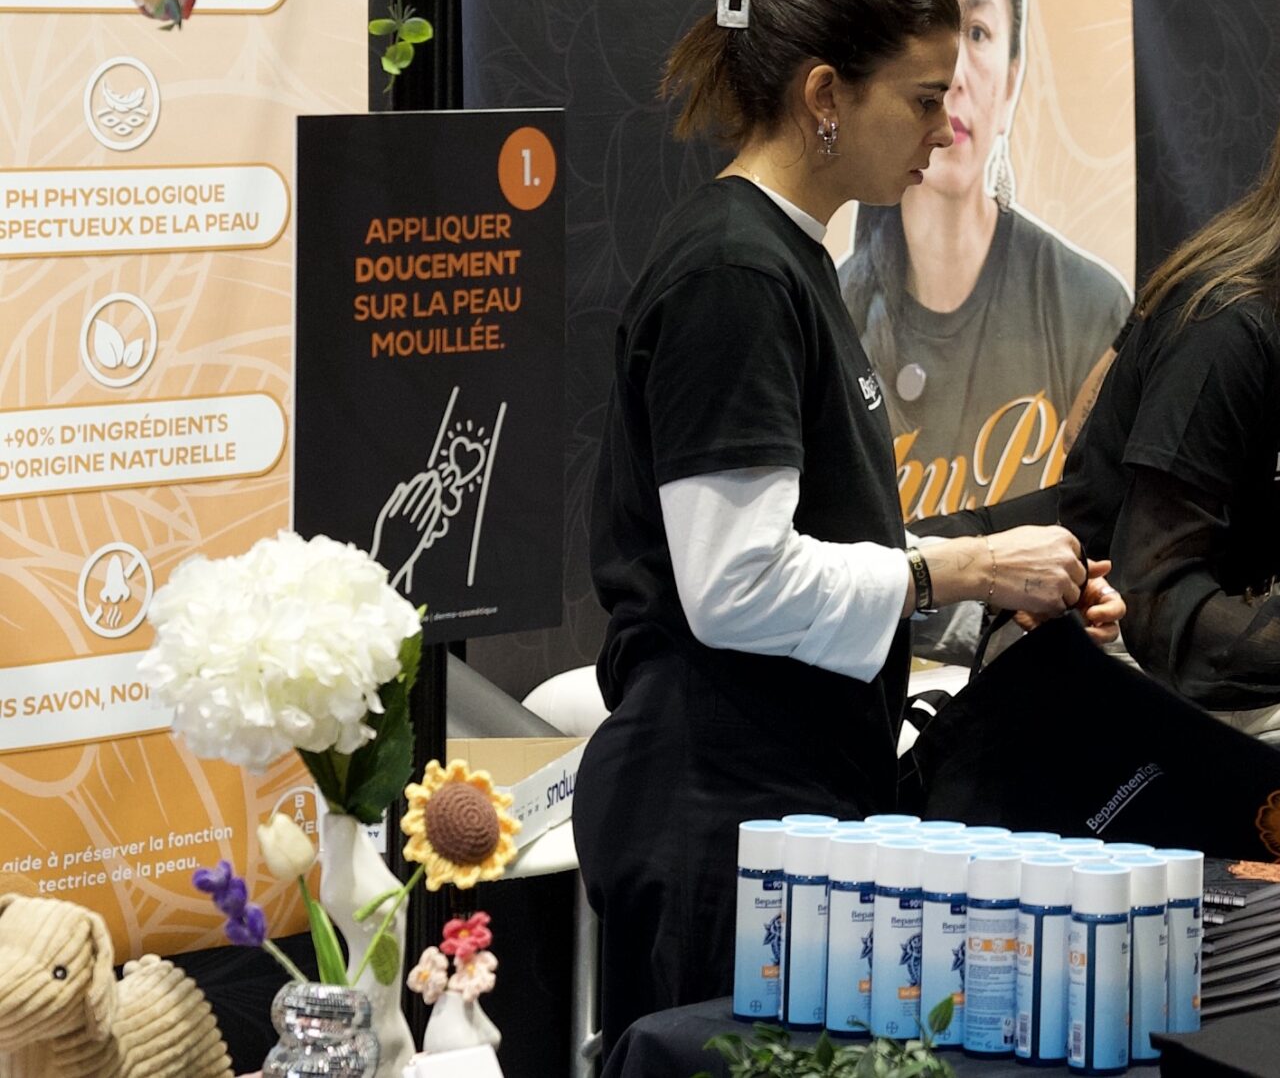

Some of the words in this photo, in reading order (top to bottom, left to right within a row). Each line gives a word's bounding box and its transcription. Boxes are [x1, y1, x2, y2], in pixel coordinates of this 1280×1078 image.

[521, 148, 541, 187] 1.
[5, 188, 38, 208] PH
[44, 184, 225, 208] PHYSIOLOGIQUE
[140, 214, 167, 235] DE
[172, 213, 200, 234] LA
[205, 211, 260, 233] PEAU
[365, 213, 512, 244] APPLIQUER
[355, 249, 522, 283] DOUCEMENT
[354, 292, 408, 322] SUR
[413, 290, 448, 318] LA
[453, 286, 522, 315] PEAU
[371, 317, 506, 359] MOUILLÉE.
[4, 425, 55, 449] +90%
[60, 412, 229, 445] D'INGRÉDIENTS
[110, 441, 237, 471] NATURELLE
[23, 687, 105, 716] SAVON,
[47, 850, 58, 868] à
[63, 841, 147, 870] préserver
[149, 831, 164, 852] la
[167, 824, 233, 849] fonction
[38, 871, 107, 893] tectrice
[112, 865, 131, 882] de
[136, 860, 151, 878] la
[155, 854, 200, 878] peau.
